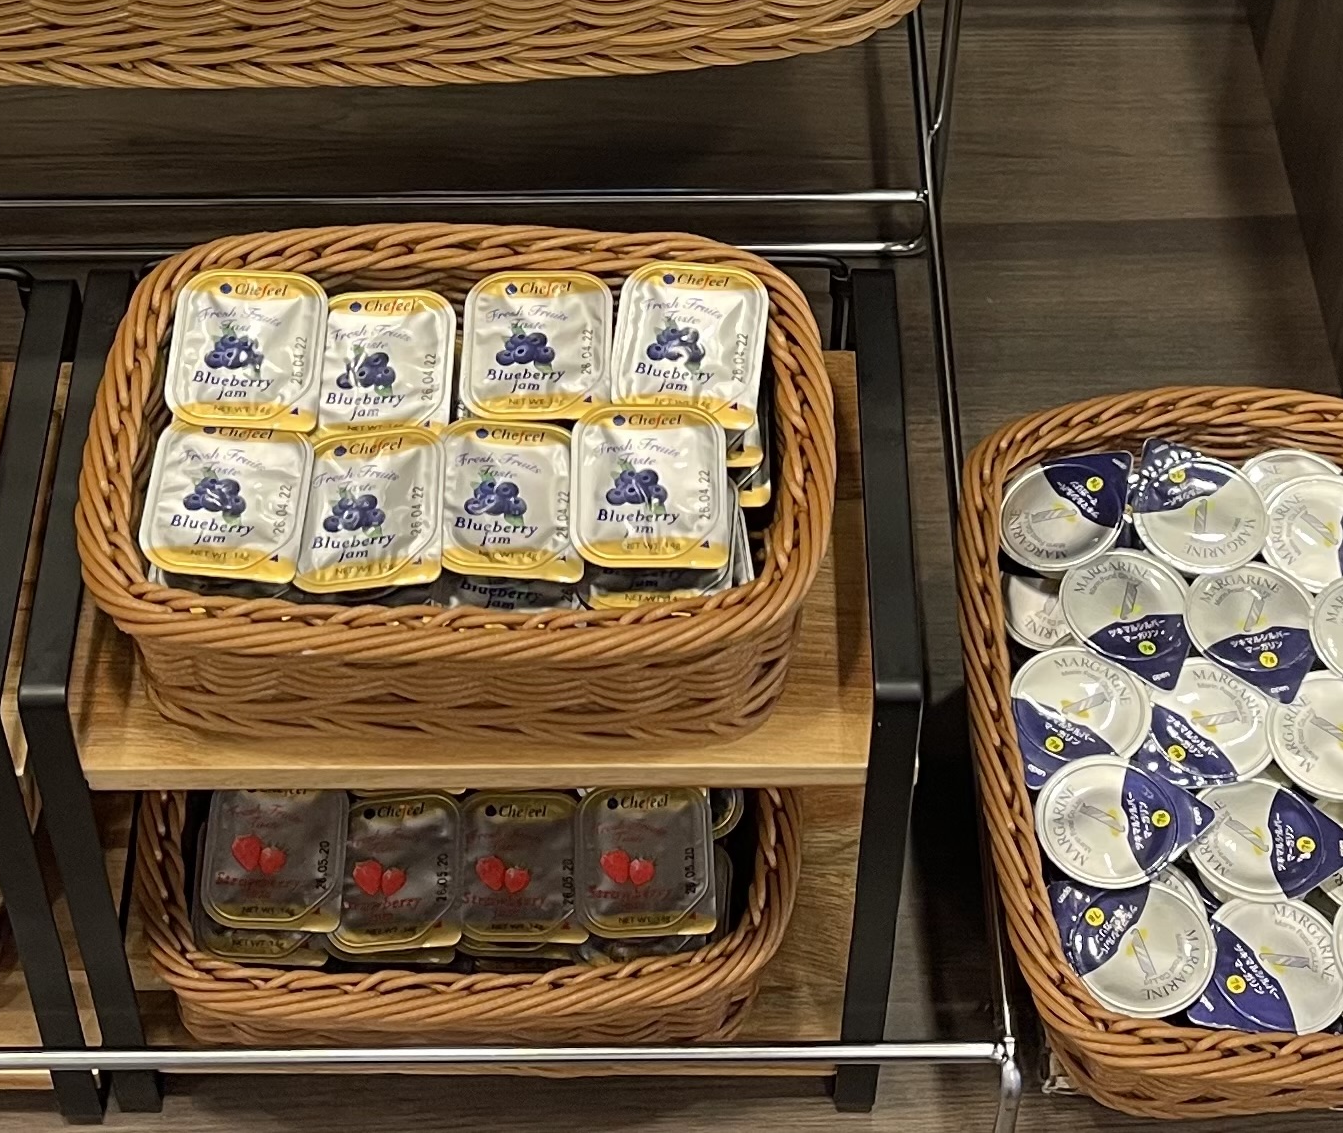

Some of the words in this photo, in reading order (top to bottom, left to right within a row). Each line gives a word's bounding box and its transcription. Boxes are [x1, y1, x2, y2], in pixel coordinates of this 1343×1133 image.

[520, 281, 572, 296] Chefeel
[677, 274, 729, 289] Chefeel
[235, 283, 288, 297] Chefeel
[365, 299, 416, 313] Chefeel
[192, 371, 274, 392] Blueberry
[487, 369, 565, 382] Blueberry
[217, 387, 247, 400] jam
[511, 380, 540, 393] jam
[658, 380, 687, 392] jam
[326, 393, 405, 407] Blueberry
[350, 407, 379, 421] jam
[628, 415, 682, 429] Chefeel
[491, 429, 545, 445] Chefeel
[349, 438, 403, 454] Chefeel
[699, 470, 710, 520] 26.04.22
[171, 514, 255, 536] Blueberry
[597, 509, 680, 525] Blueberry
[454, 517, 538, 538] Blueberry
[1272, 492, 1303, 565] MARGARINE
[194, 532, 226, 544] jam
[312, 534, 396, 549] Blueberry
[480, 532, 511, 546] jam
[1185, 518, 1256, 558] MARGARINE
[338, 550, 368, 562] jam
[1074, 562, 1151, 594] MARGARINE
[1200, 575, 1280, 603] MARGARINE
[1054, 657, 1132, 705] MARGARNE
[1167, 726, 1204, 757] ーガリン
[378, 802, 425, 818] Chefeel
[621, 794, 668, 810] Chefeel
[499, 805, 547, 817] Chefeel
[1274, 904, 1335, 982] MARGARINE
[1145, 929, 1200, 1000] MARGARINE
